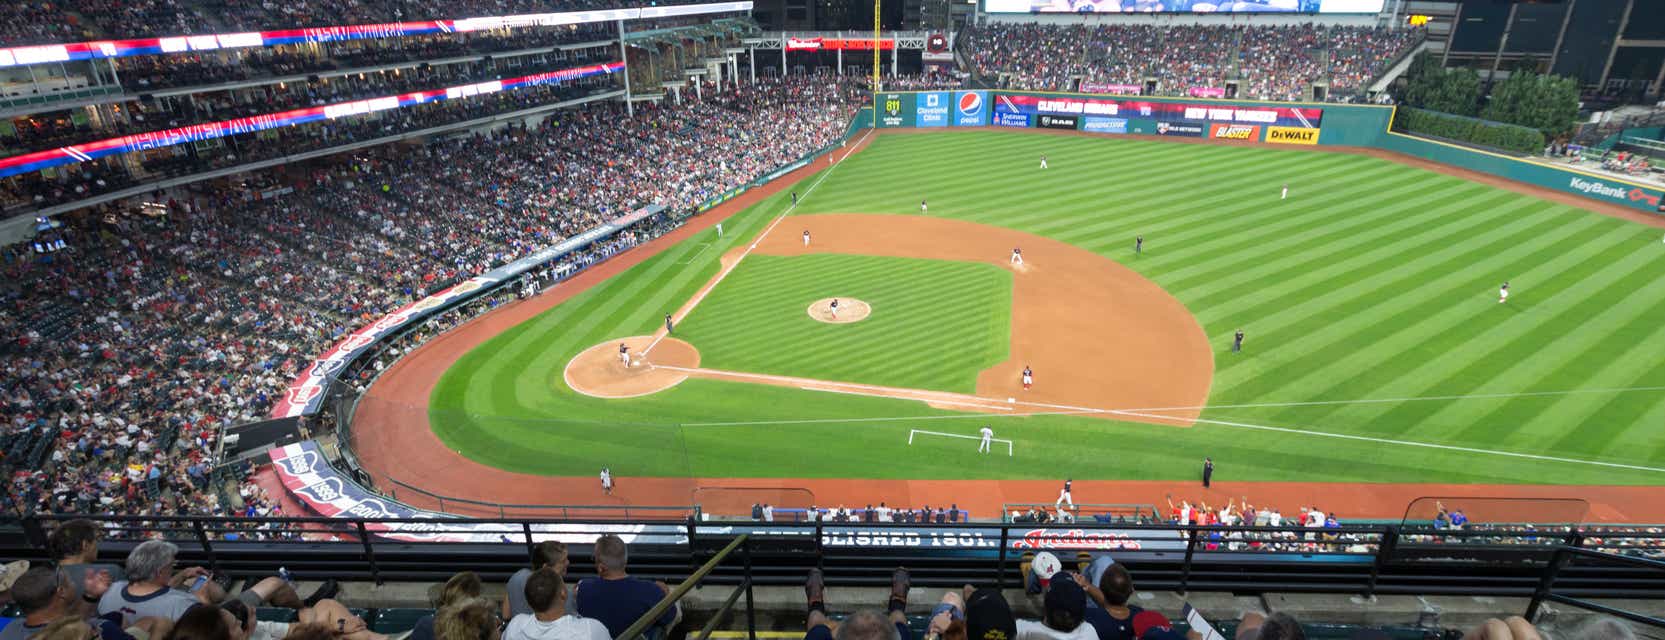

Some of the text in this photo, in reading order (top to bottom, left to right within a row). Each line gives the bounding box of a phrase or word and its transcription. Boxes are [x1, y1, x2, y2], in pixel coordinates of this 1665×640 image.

[886, 100, 900, 112] 811
[917, 107, 948, 115] Cleveland
[1037, 101, 1083, 114] CLEVELAND
[1184, 107, 1207, 119] NEW
[1208, 109, 1234, 121] YORK
[1235, 109, 1278, 122] YANKEES
[960, 117, 980, 125] pepsi
[1215, 126, 1253, 139] BLASTER
[1570, 177, 1626, 198] KeyBank
[1013, 529, 1141, 551] Indians
